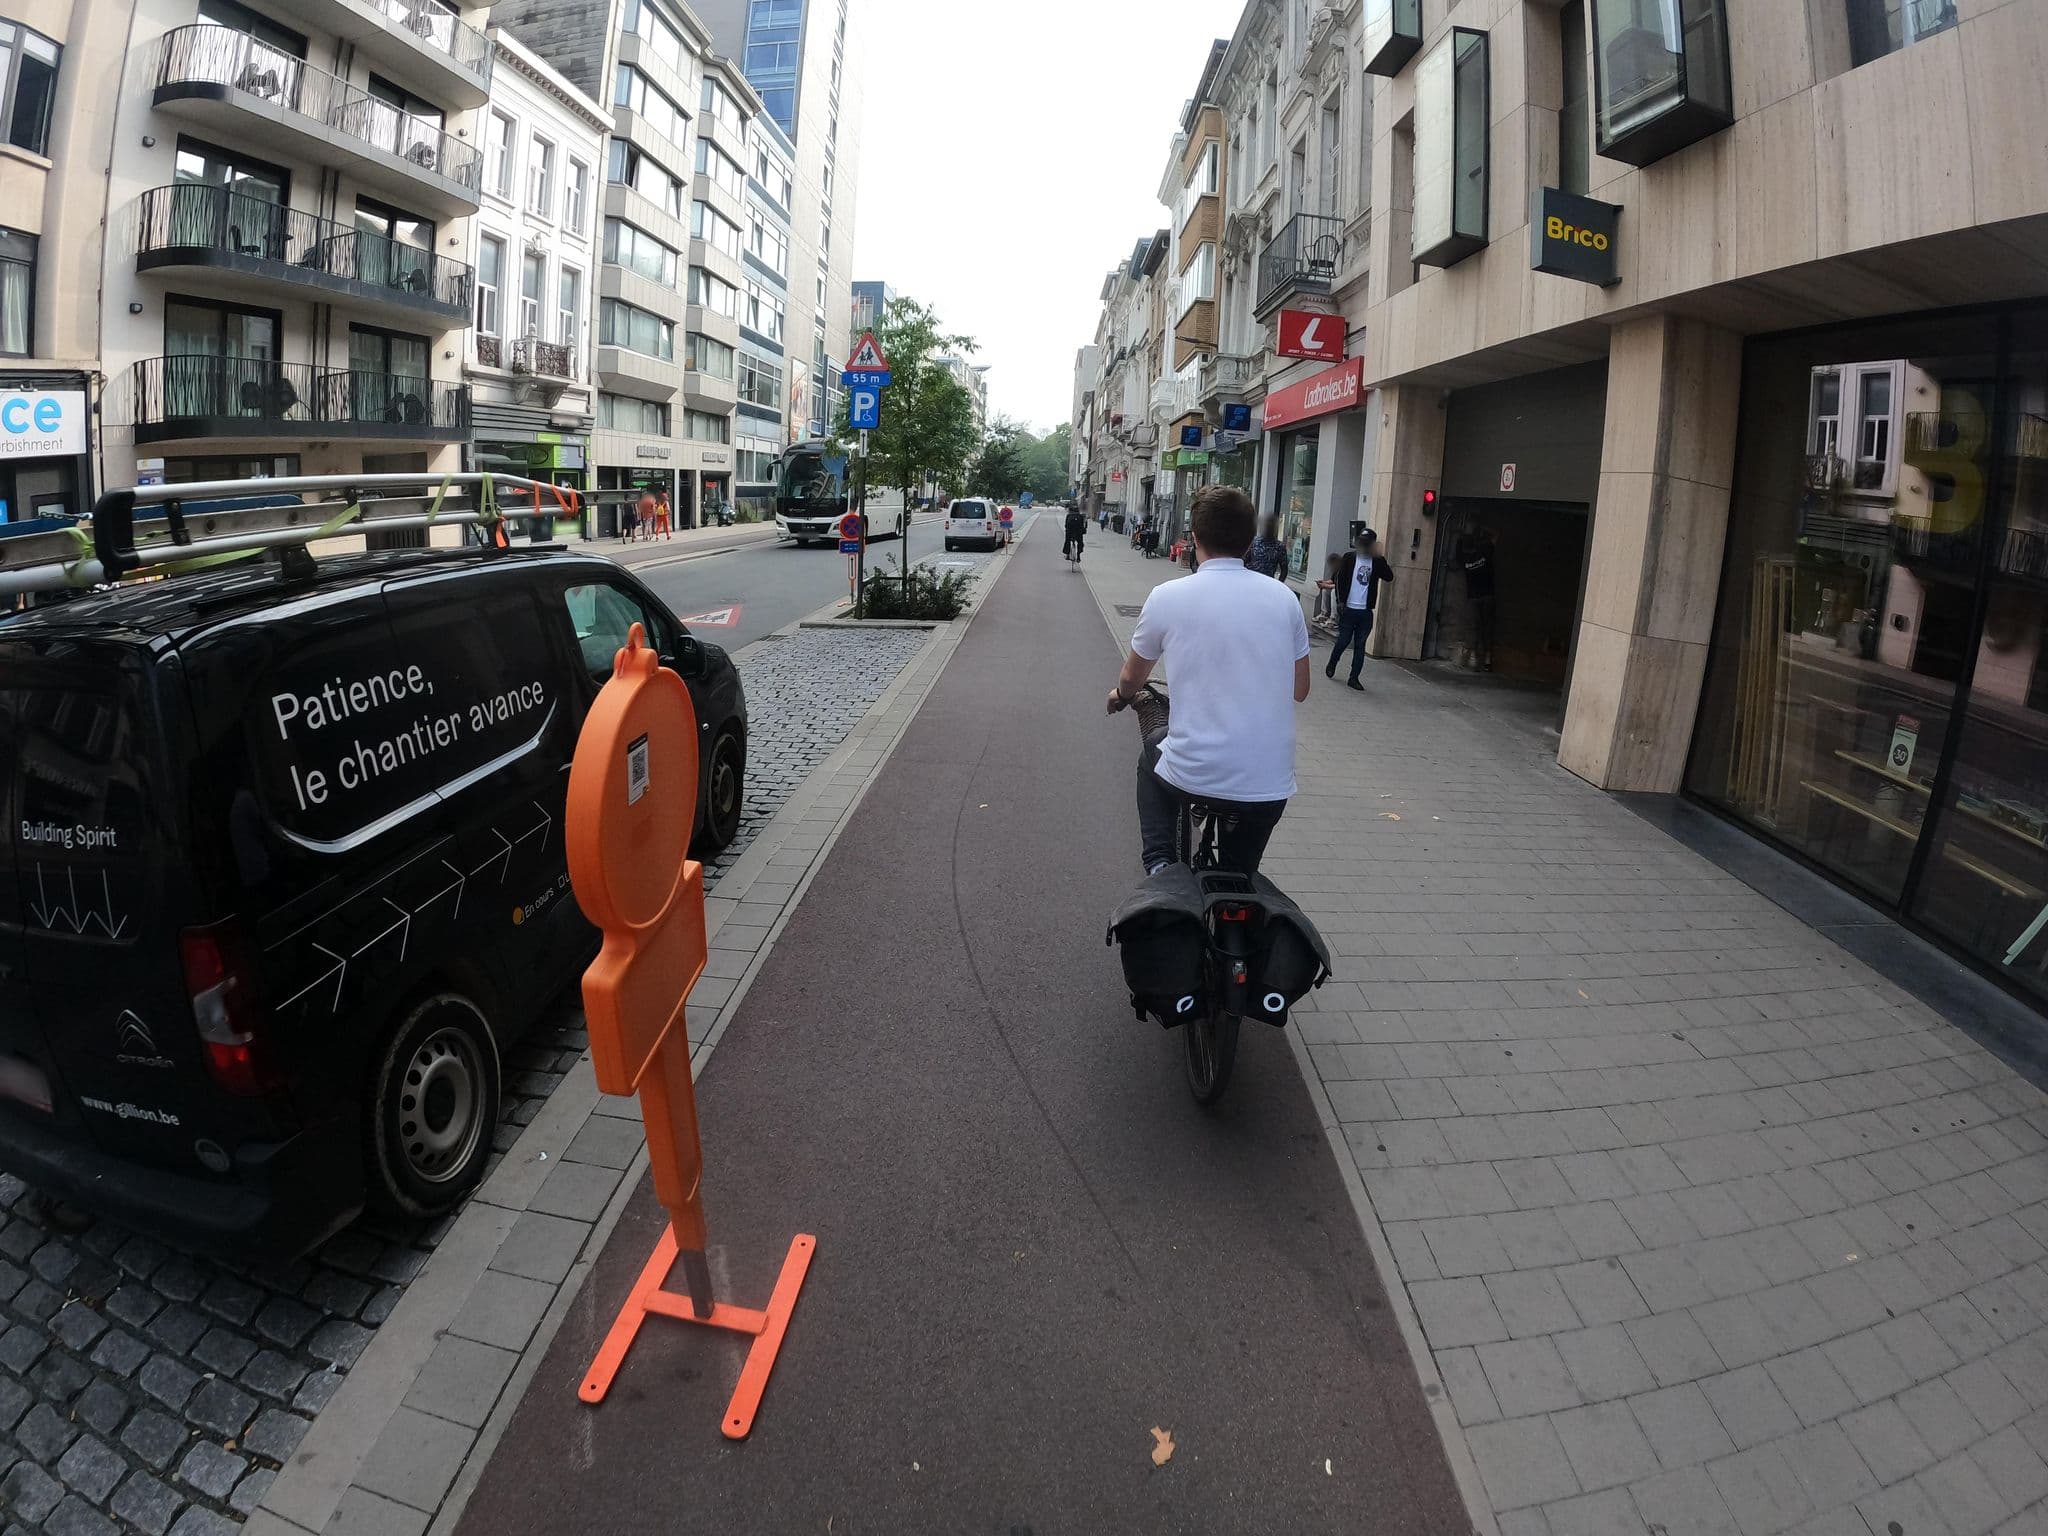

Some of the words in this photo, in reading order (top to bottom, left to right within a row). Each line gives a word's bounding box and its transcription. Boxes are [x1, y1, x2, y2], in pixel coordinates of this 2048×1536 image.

[1547, 215, 1608, 251] Brico
[852, 373, 868, 383] 55
[1303, 370, 1357, 410] Ladbrokes.be
[854, 392, 875, 421] P
[0, 438, 63, 453] rbishment
[272, 664, 433, 740] Patience,
[290, 765, 328, 810] le
[338, 713, 461, 789] chantier
[469, 681, 544, 732] avance
[21, 820, 73, 850] Building
[75, 824, 118, 850] Spirit
[524, 904, 535, 919] En
[534, 887, 555, 909] cours
[80, 1095, 181, 1126] www.gillion.be
